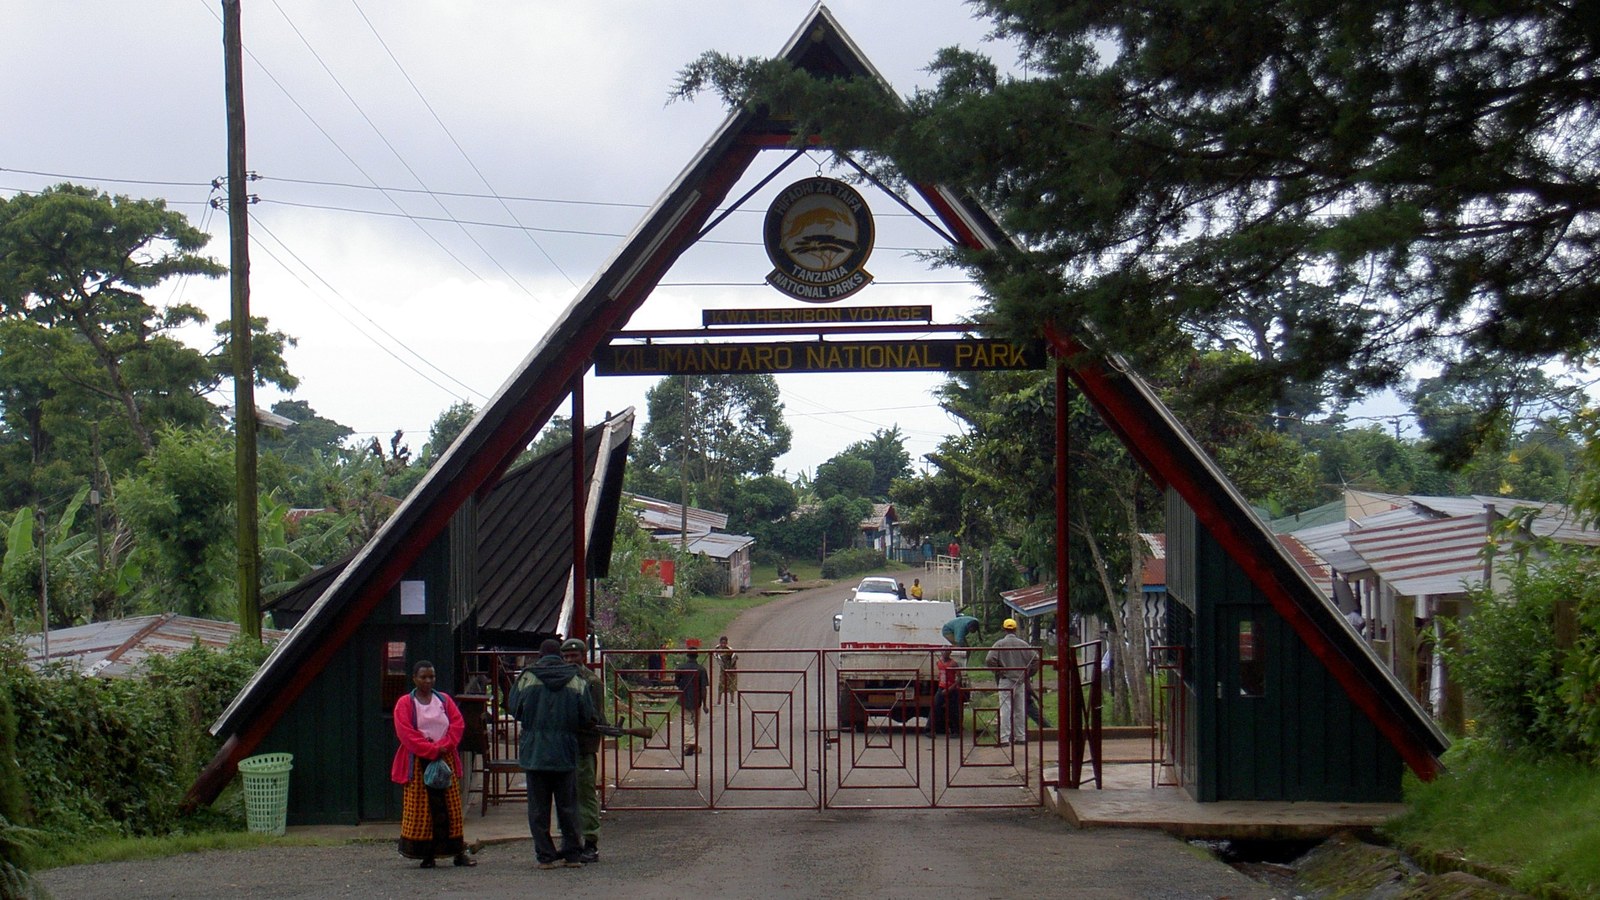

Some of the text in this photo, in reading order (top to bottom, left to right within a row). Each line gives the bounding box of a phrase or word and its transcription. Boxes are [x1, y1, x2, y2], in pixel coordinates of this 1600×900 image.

[774, 182, 862, 216] HIFADHI ZA TAIFA
[773, 273, 863, 298] NATIONAL PARKS
[791, 264, 848, 282] TANZANIA
[848, 306, 923, 321] VOYAGE
[614, 343, 1029, 371] KILIMANJARO NATIONAL PARK
